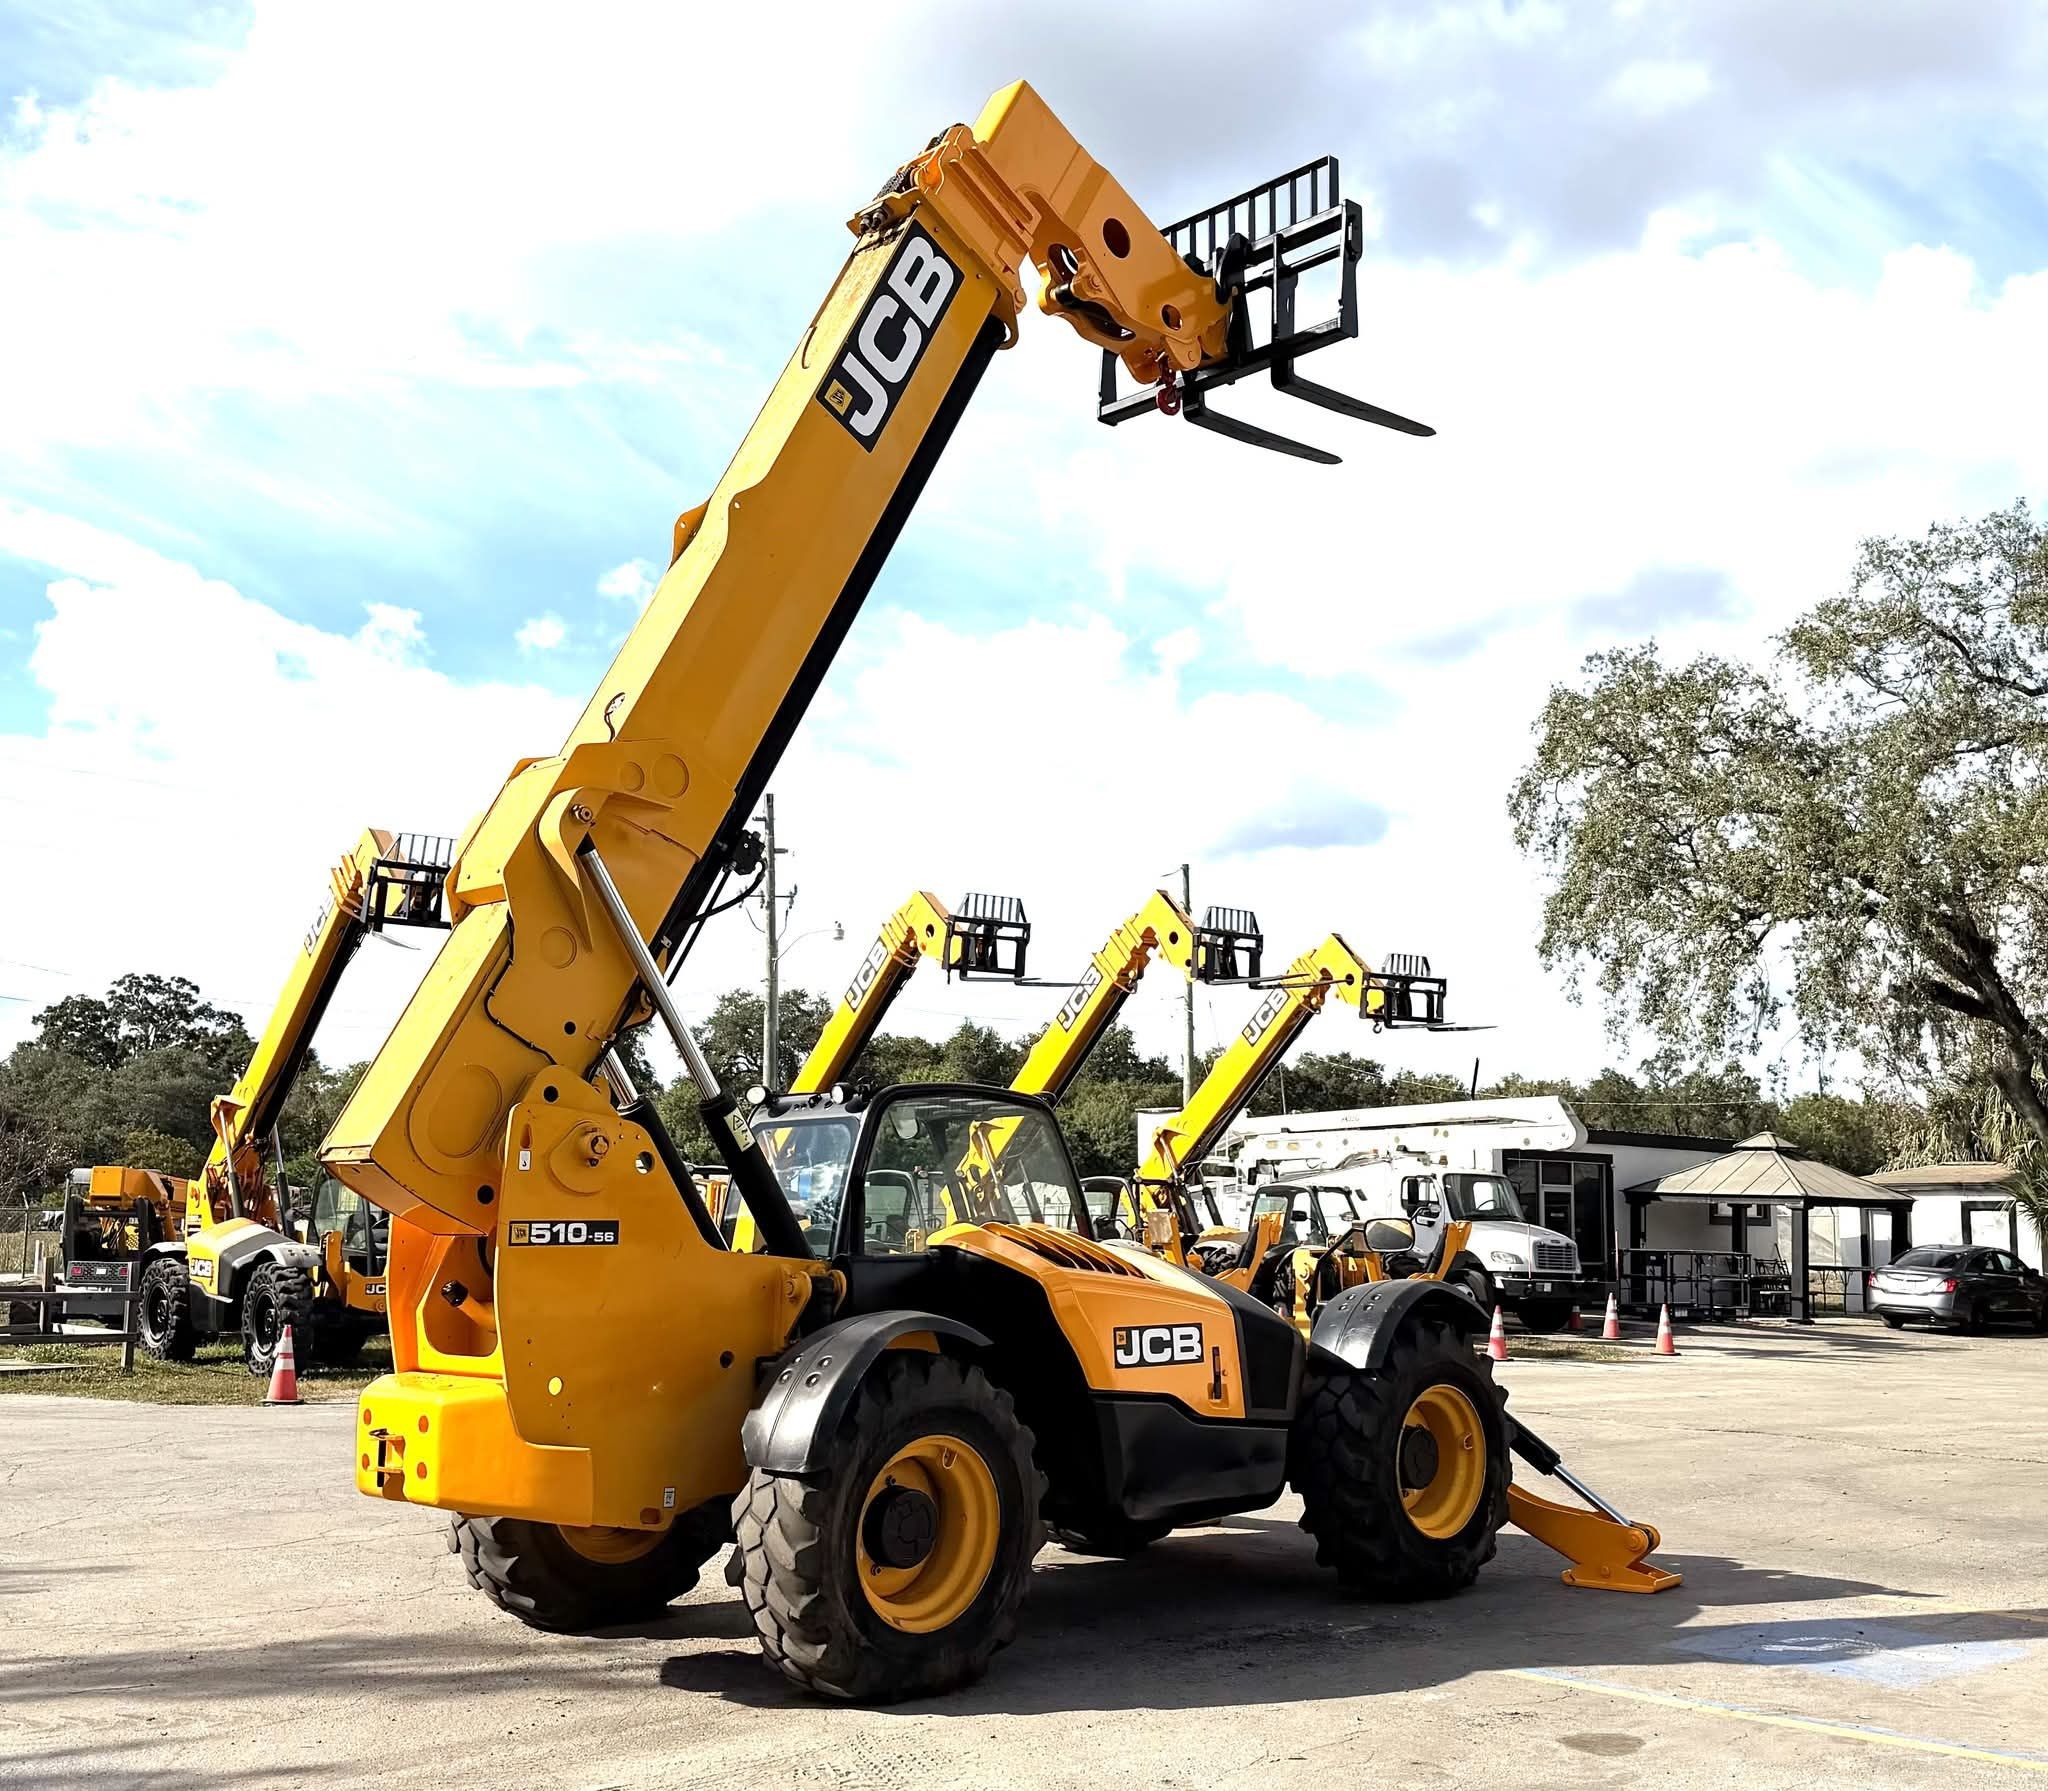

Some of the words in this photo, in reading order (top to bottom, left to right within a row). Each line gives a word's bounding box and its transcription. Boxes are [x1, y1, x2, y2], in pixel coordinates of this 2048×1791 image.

[842, 236, 954, 437] JCB
[849, 938, 888, 1009] JCB
[1061, 964, 1103, 1030] JCB
[1246, 987, 1288, 1045] JCB
[530, 1223, 615, 1243] 510-56
[190, 1259, 212, 1276] JCB
[366, 1284, 386, 1294] JC
[1116, 1326, 1201, 1365] JCB
